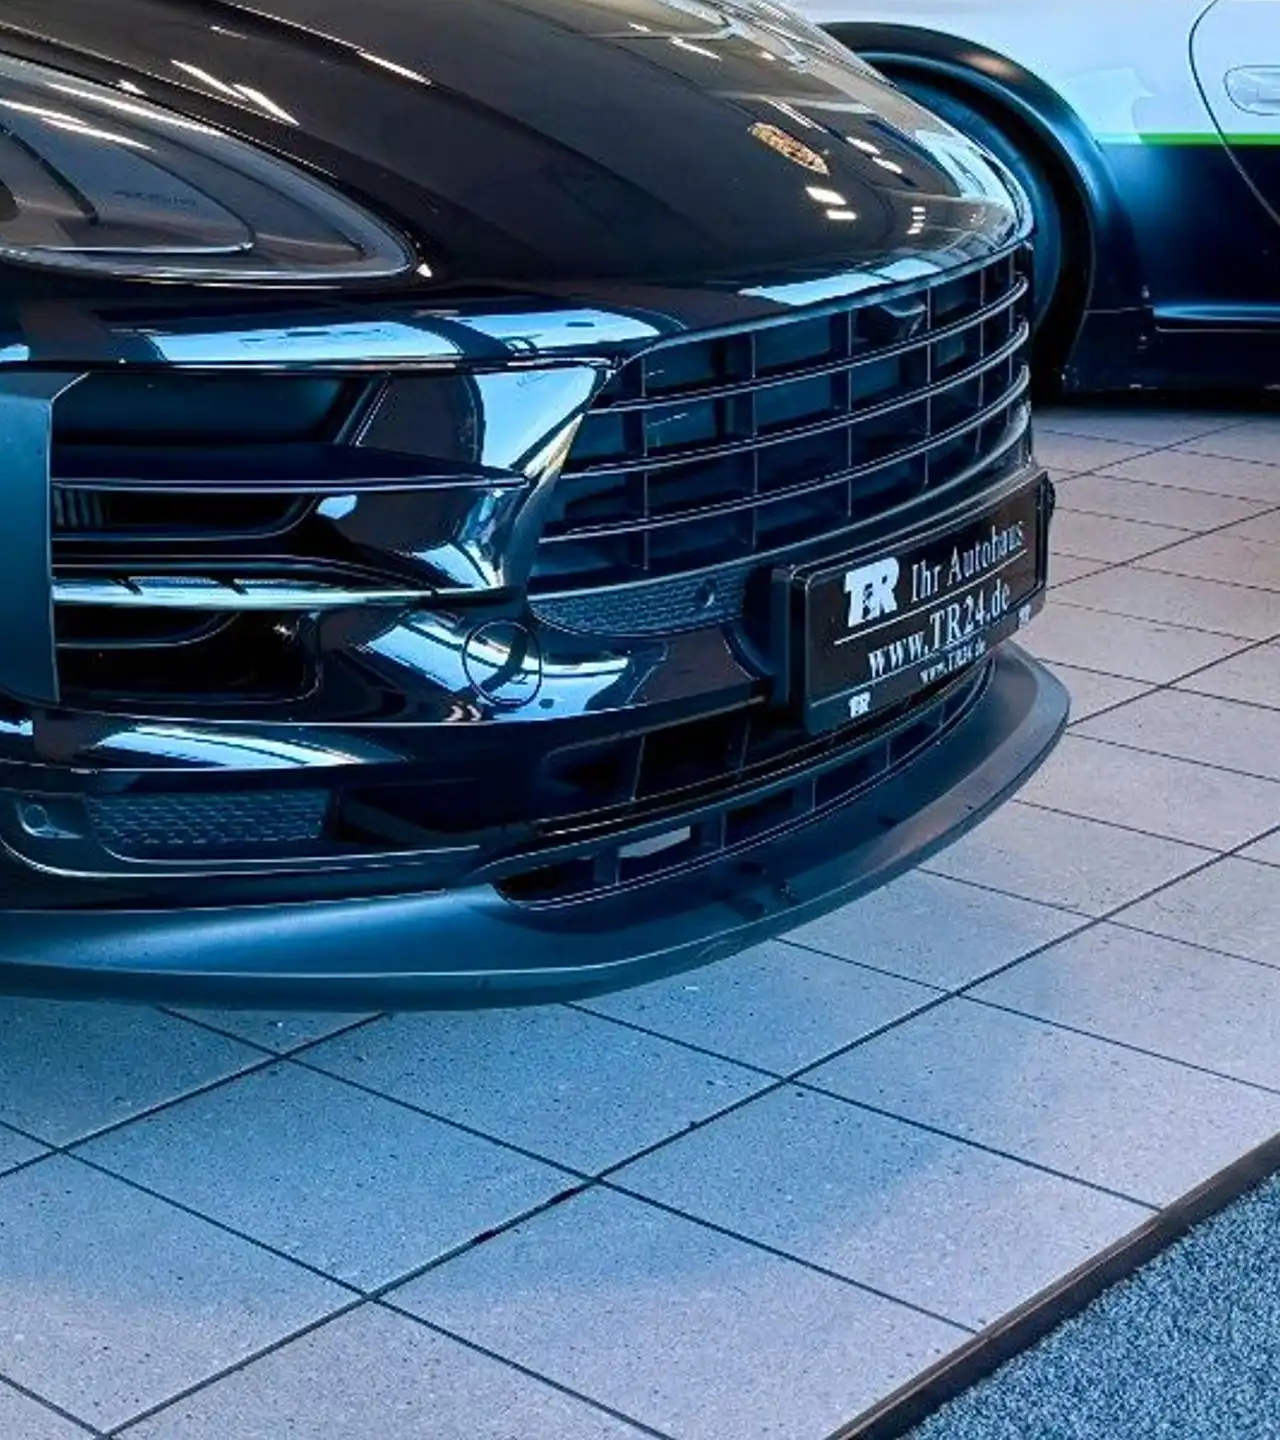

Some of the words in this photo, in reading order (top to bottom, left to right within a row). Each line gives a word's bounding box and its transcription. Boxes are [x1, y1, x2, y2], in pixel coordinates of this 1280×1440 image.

[910, 560, 940, 603] Ihr
[947, 521, 1024, 586] Autohaus
[868, 578, 1010, 678] www.TR24.de
